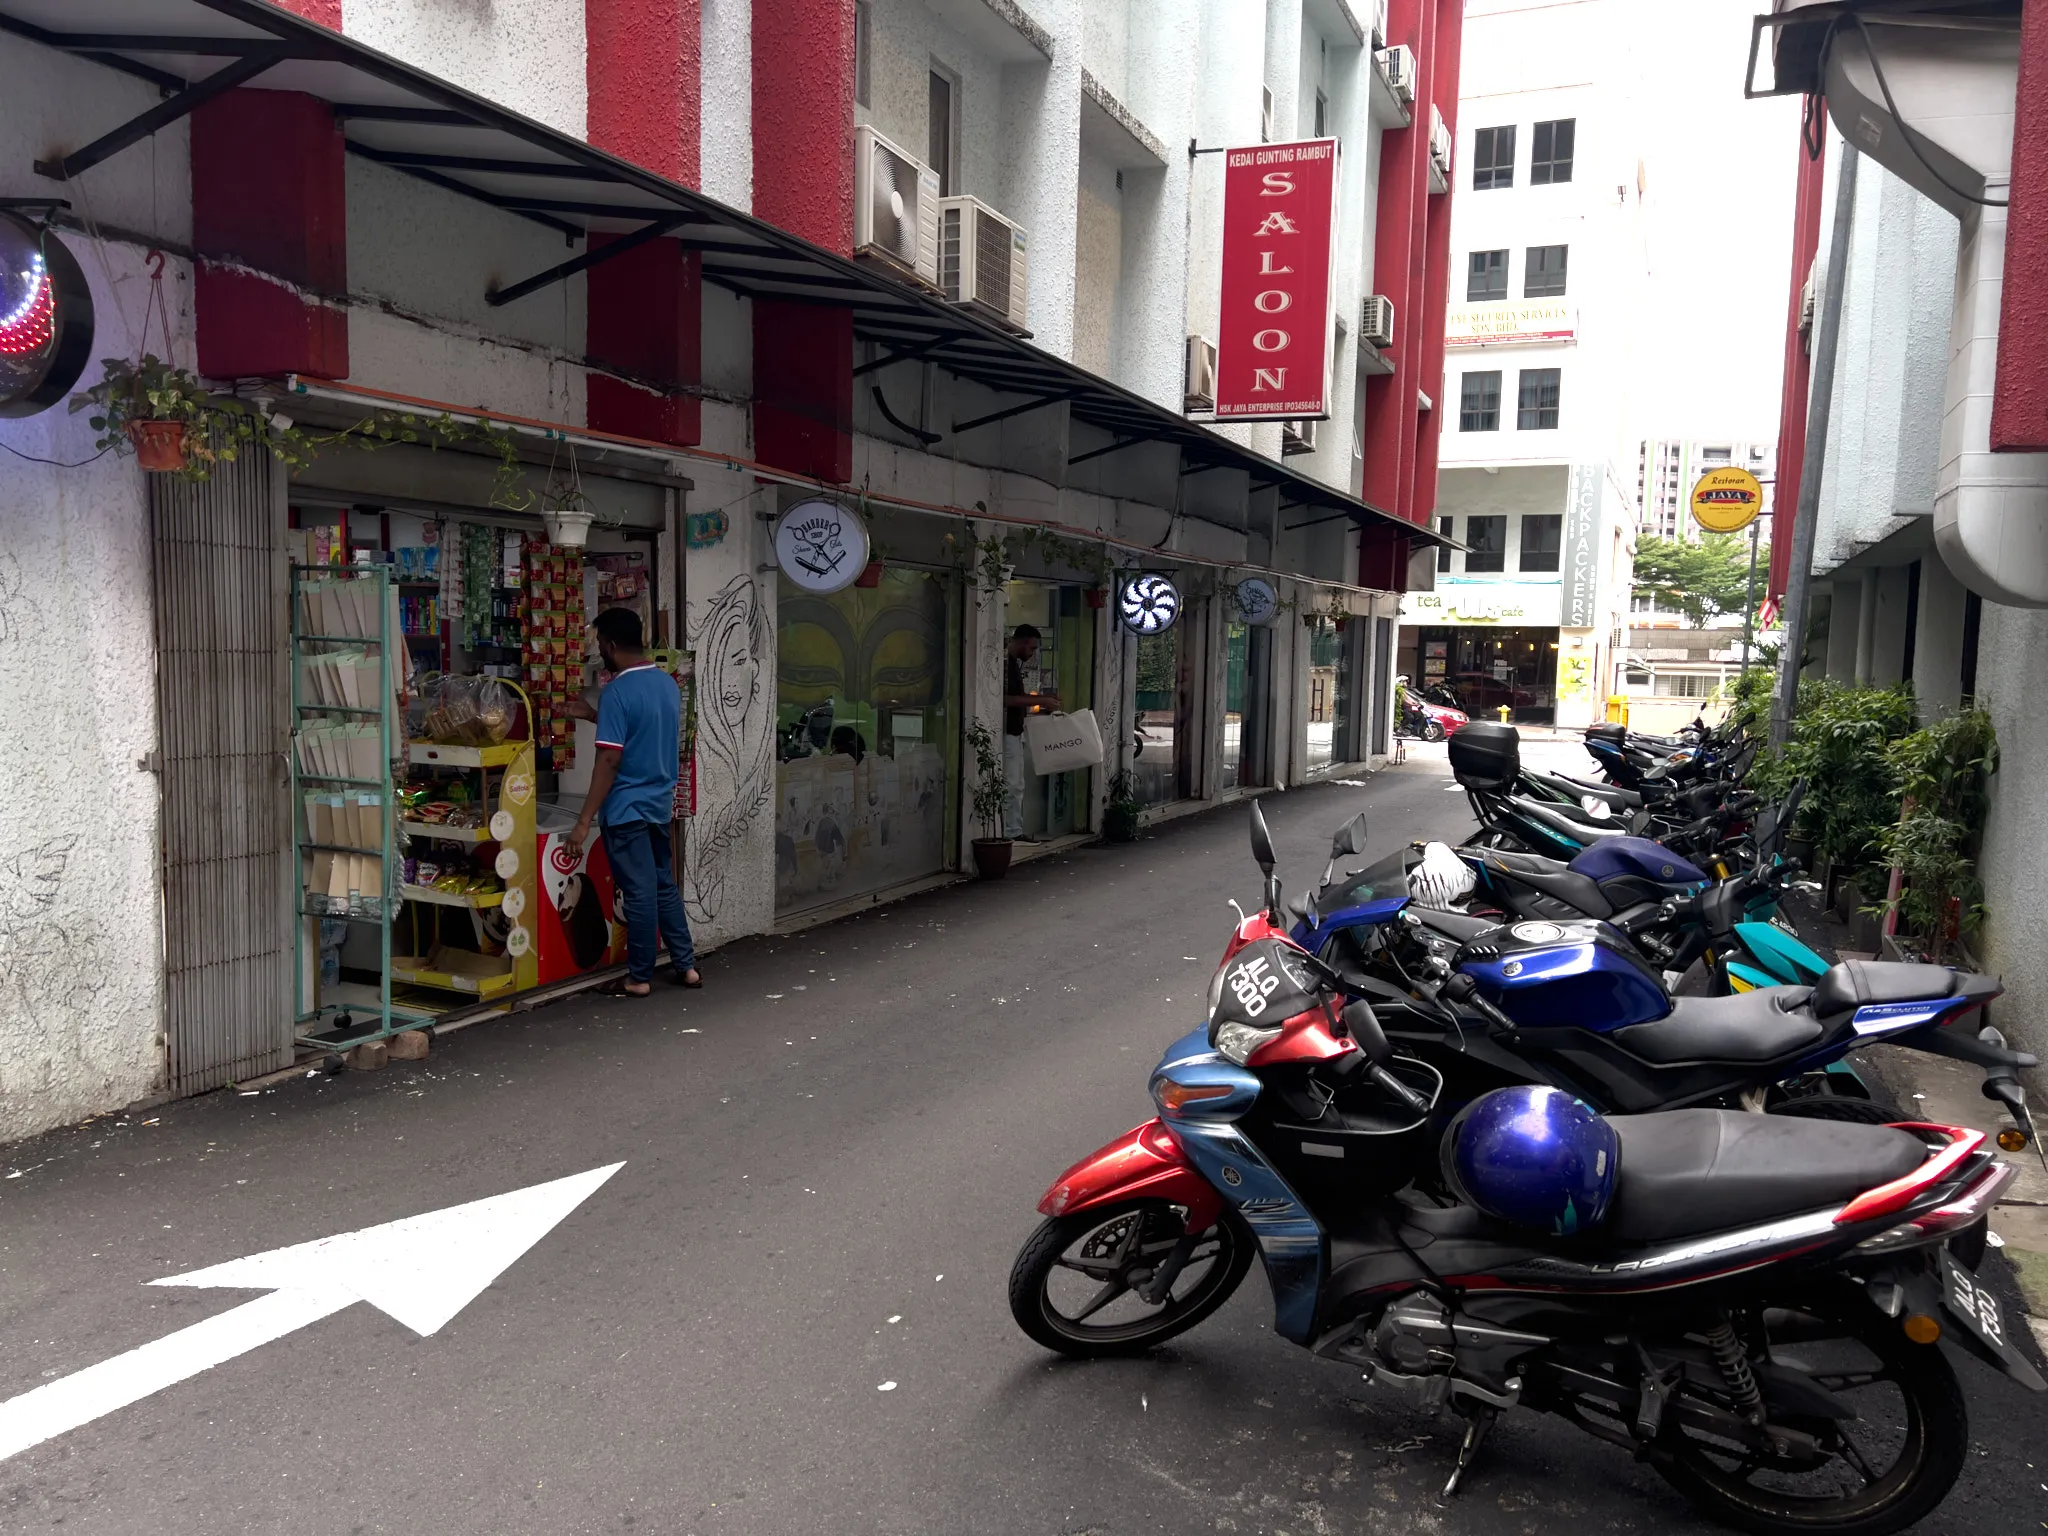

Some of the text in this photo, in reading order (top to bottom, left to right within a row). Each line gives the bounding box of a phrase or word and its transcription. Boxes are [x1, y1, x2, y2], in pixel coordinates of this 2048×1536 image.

[1229, 145, 1332, 168] KEDAI GUNTING RAMBUT
[1250, 171, 1300, 392] SALOON
[1248, 402, 1283, 412] ENTERPRISE
[1711, 476, 1746, 485] Restoran
[1709, 491, 1742, 500] JAYA
[801, 518, 830, 533] BARBER
[1571, 464, 1597, 627] BACKPACKERS
[1417, 595, 1442, 608] tea
[1501, 605, 1524, 617] cafe
[1044, 738, 1083, 752] MANGO
[1245, 956, 1280, 998] ALQ
